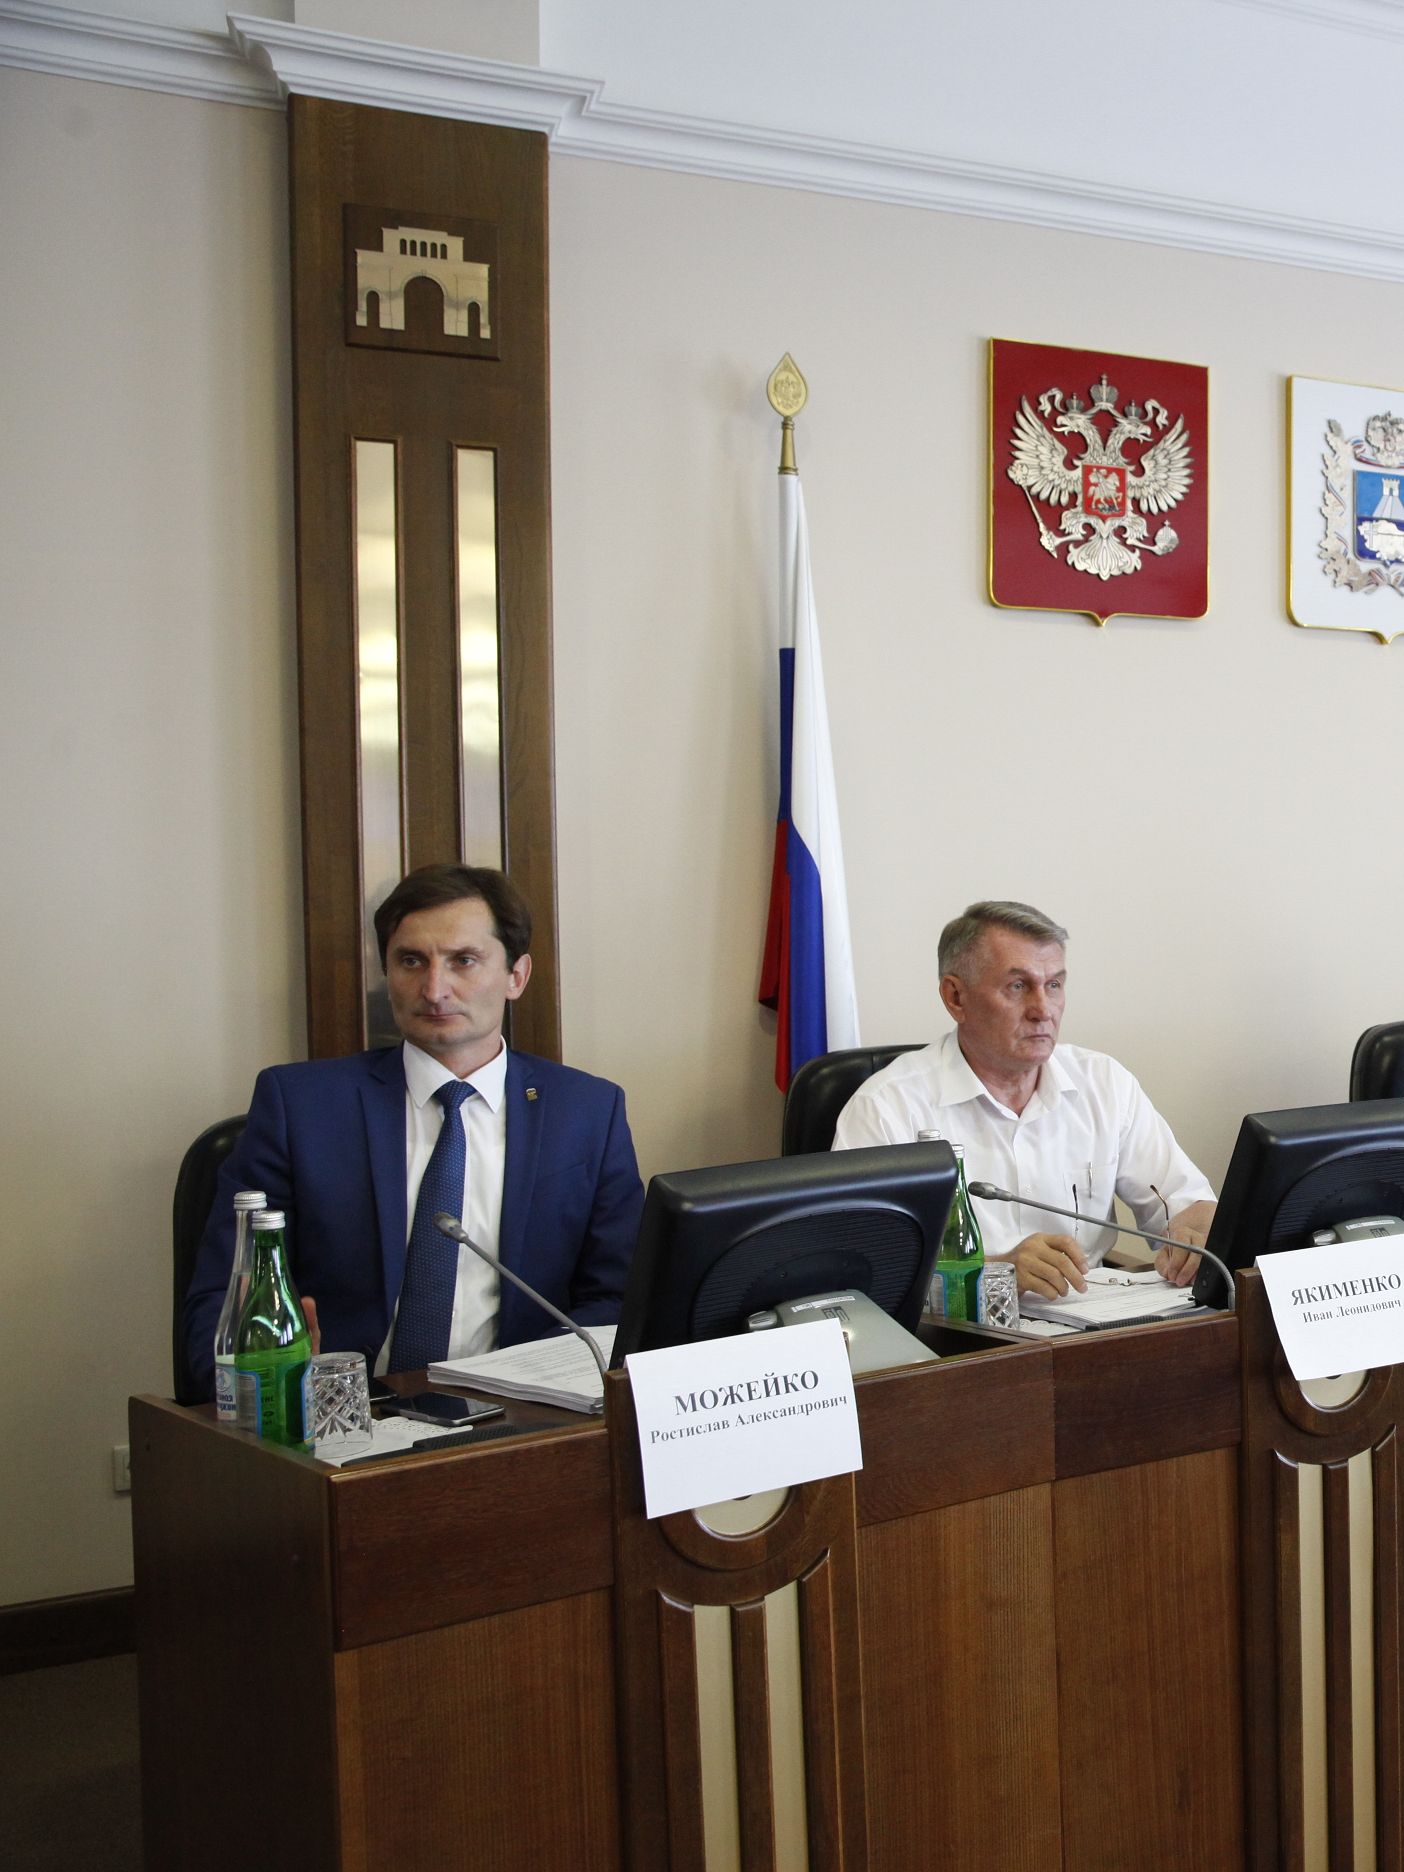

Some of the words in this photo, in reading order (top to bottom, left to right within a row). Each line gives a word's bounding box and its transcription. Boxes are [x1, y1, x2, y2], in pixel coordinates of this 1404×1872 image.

[1291, 1273, 1402, 1306] ЯКИМЕНКО
[1303, 1309, 1333, 1323] Иван
[1336, 1299, 1402, 1318] Леонидович
[674, 1370, 819, 1416] МОЖЕЙКО
[650, 1419, 730, 1444] Ростислав
[735, 1395, 848, 1427] Александрович
